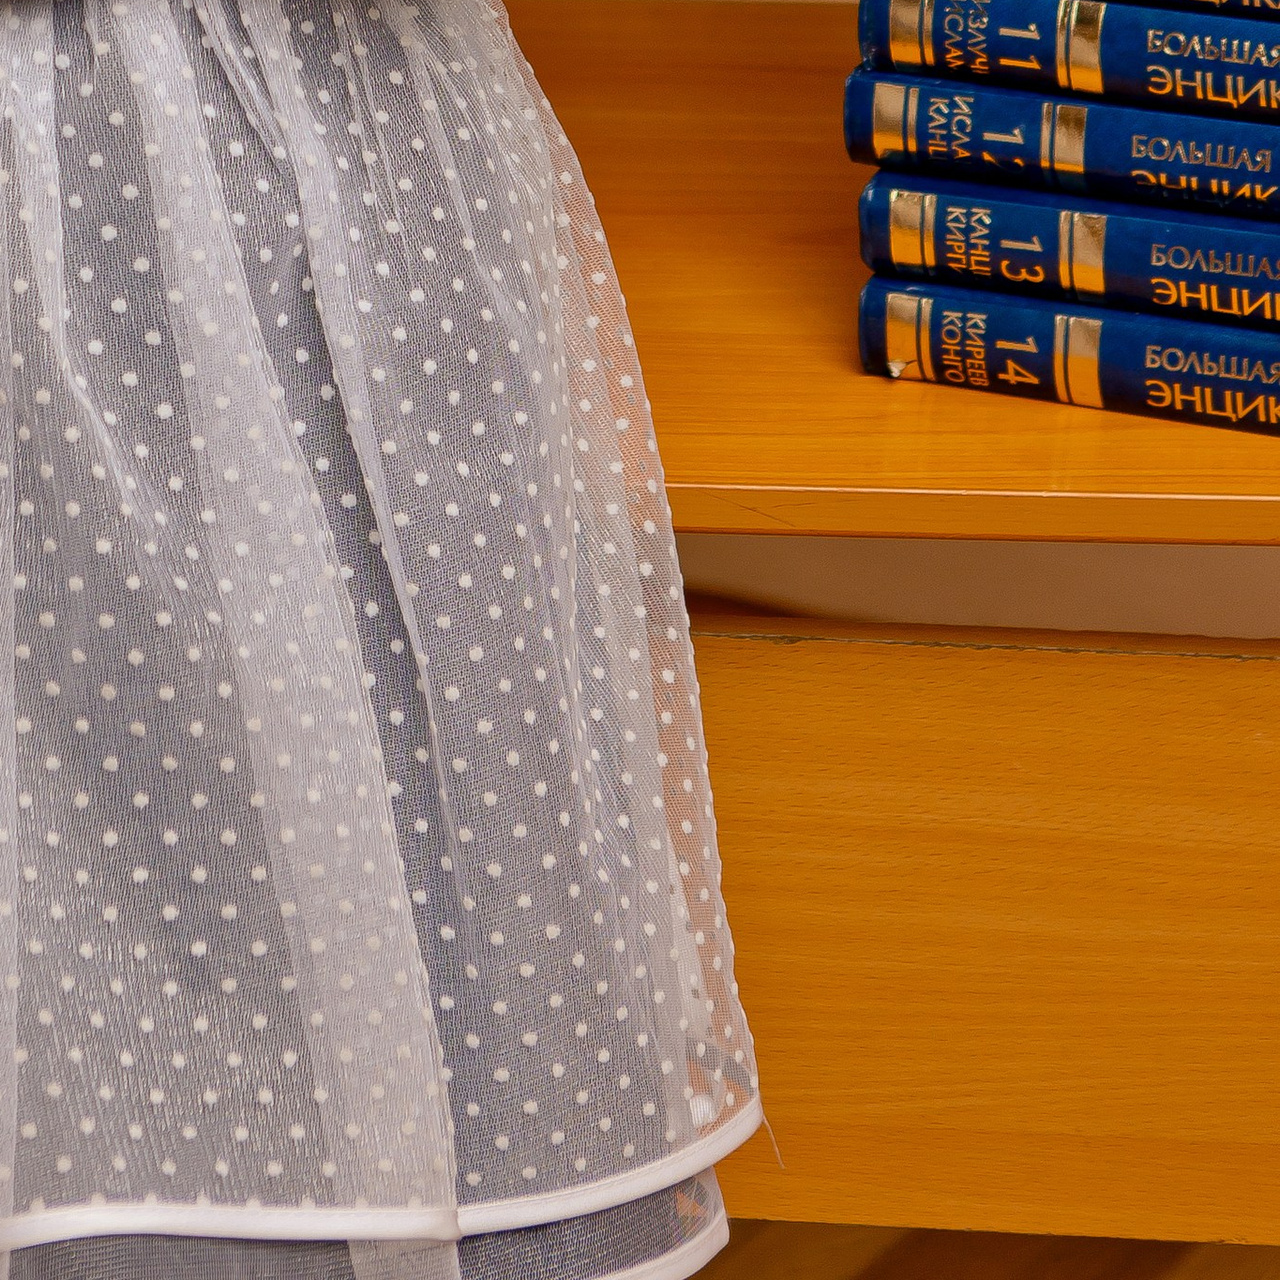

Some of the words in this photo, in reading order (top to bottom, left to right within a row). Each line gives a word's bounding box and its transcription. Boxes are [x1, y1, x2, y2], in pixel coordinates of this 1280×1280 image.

[998, 23, 1041, 70] 11
[950, 95, 974, 165] ИСЛА
[1131, 134, 1272, 173] БОЛЬШАЯ
[1000, 236, 1045, 283] 13
[942, 311, 965, 383] КОНГО
[966, 312, 989, 387] КИРЕЕВ
[995, 336, 1039, 385] 14
